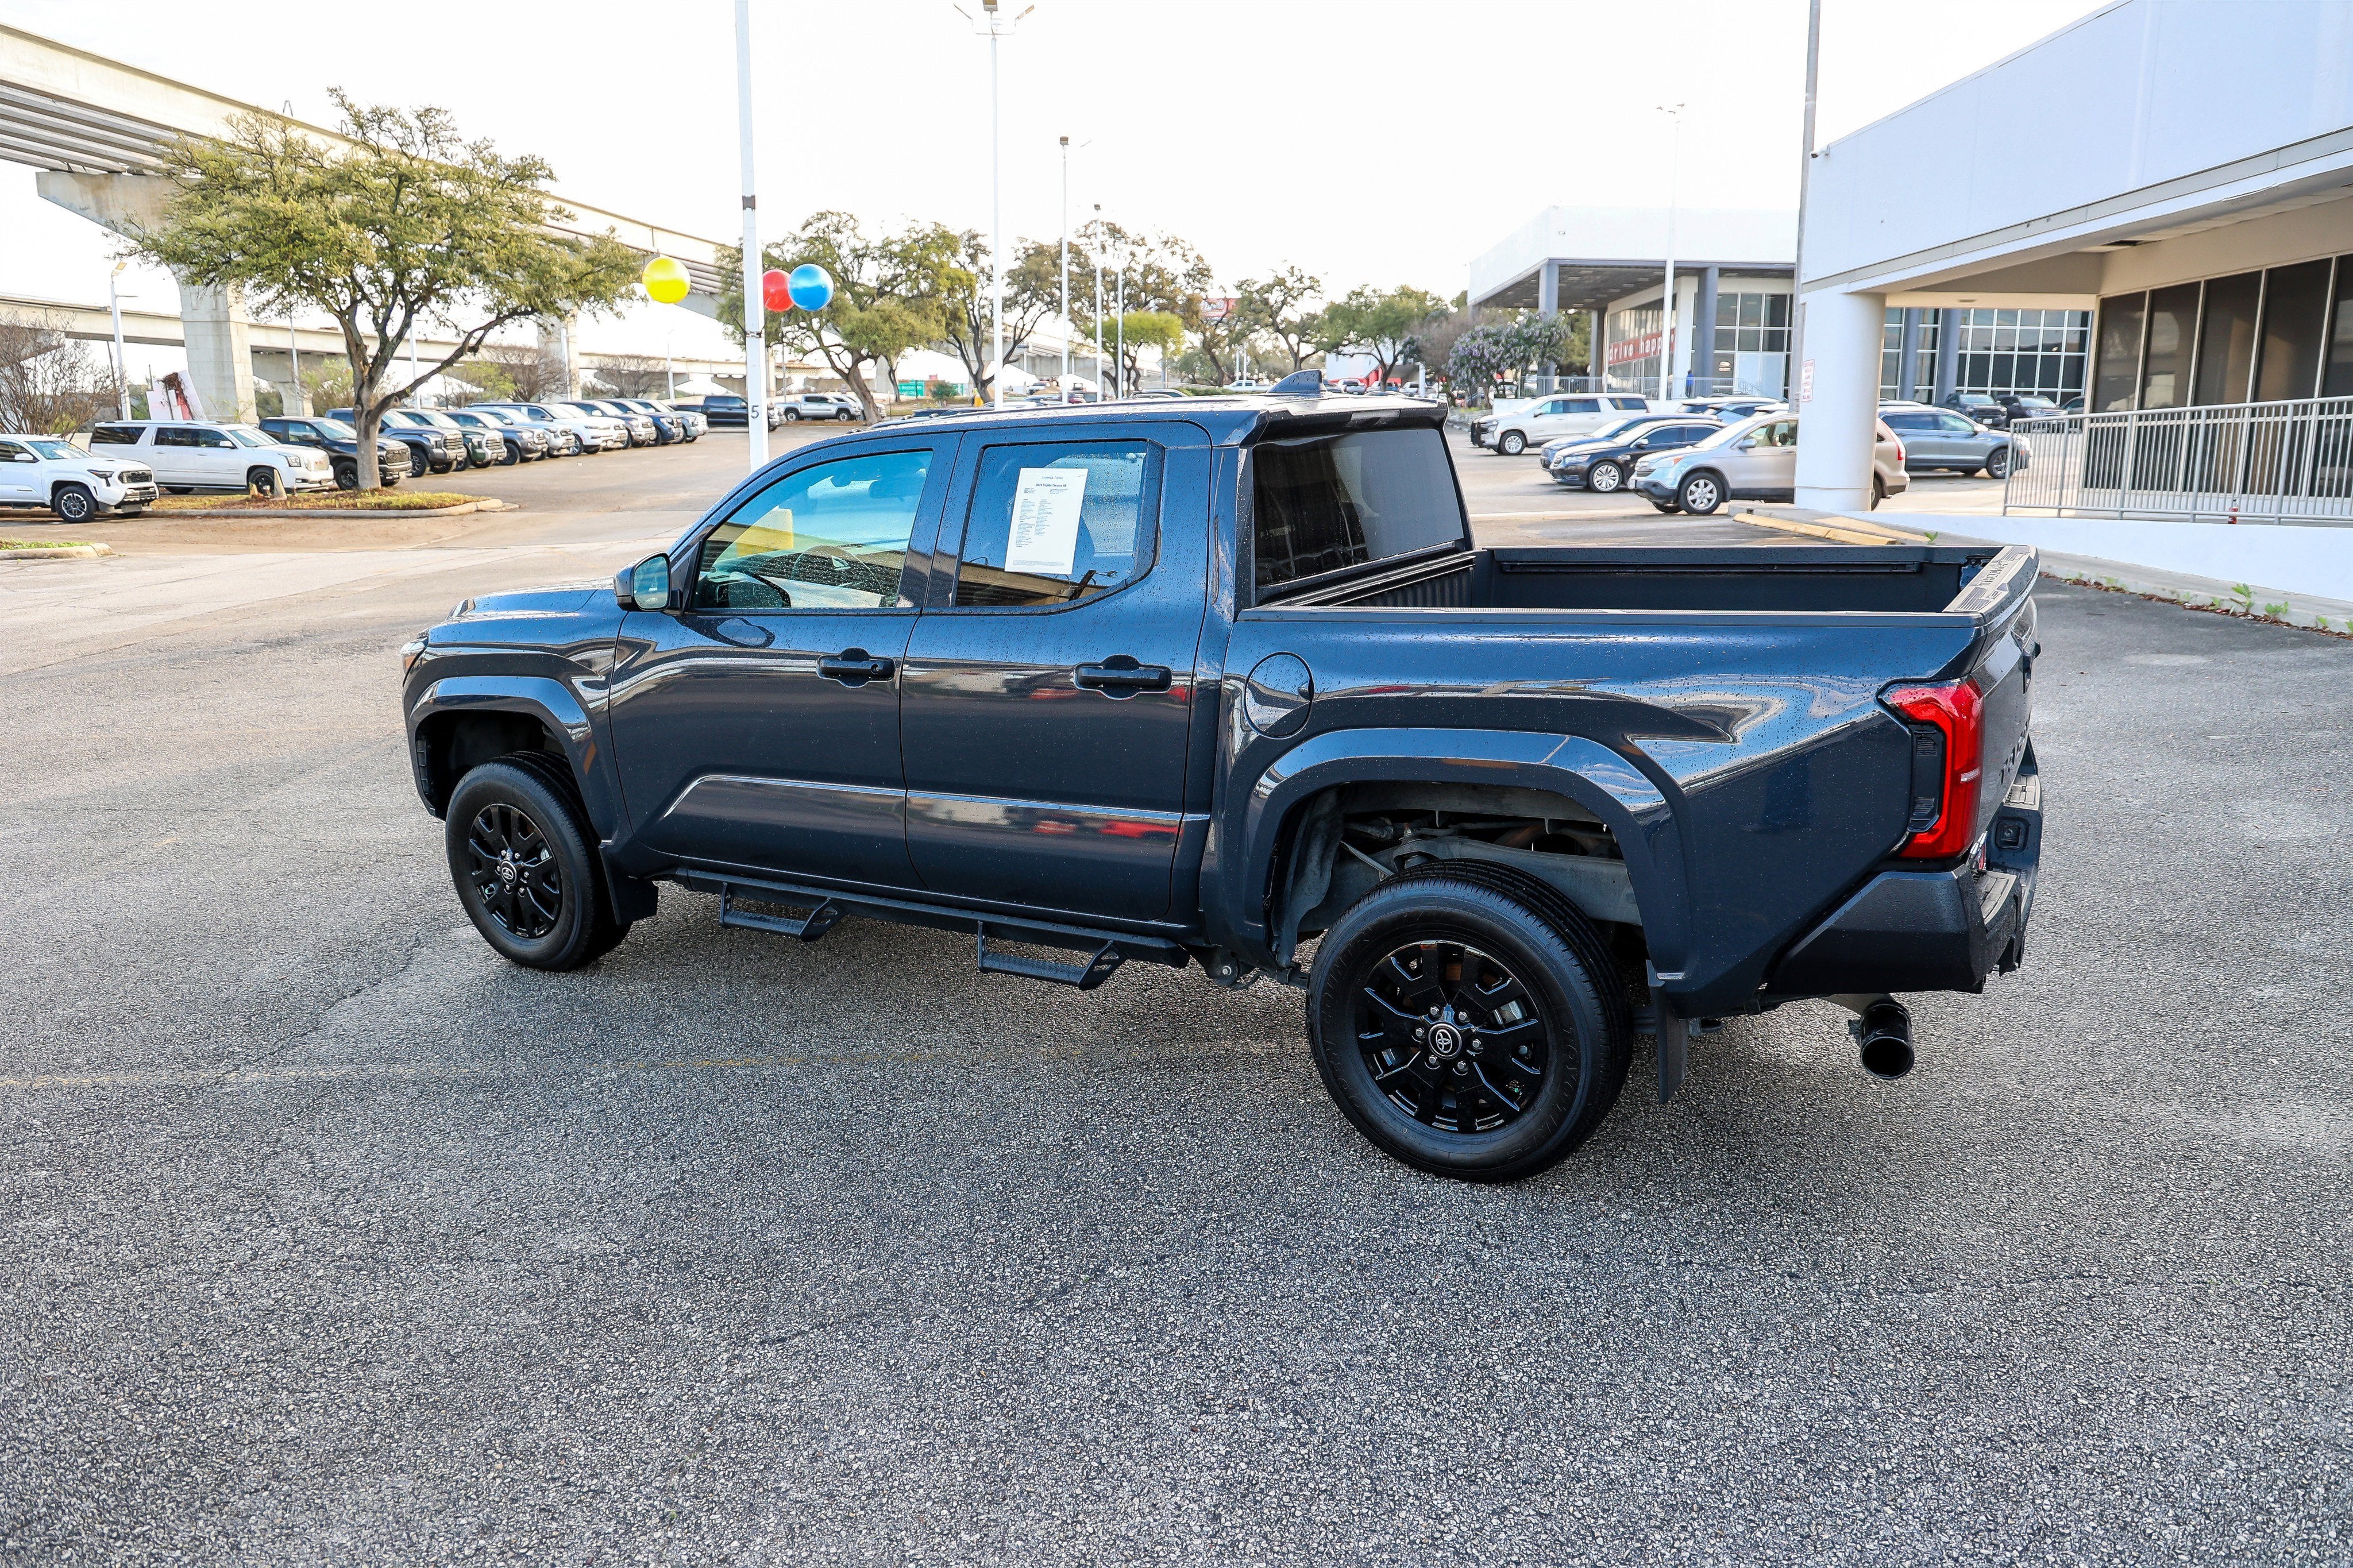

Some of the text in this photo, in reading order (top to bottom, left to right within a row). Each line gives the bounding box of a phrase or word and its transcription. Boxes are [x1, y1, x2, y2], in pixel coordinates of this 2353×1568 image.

[1609, 334, 1673, 361] drive happ
[751, 405, 759, 419] 5
